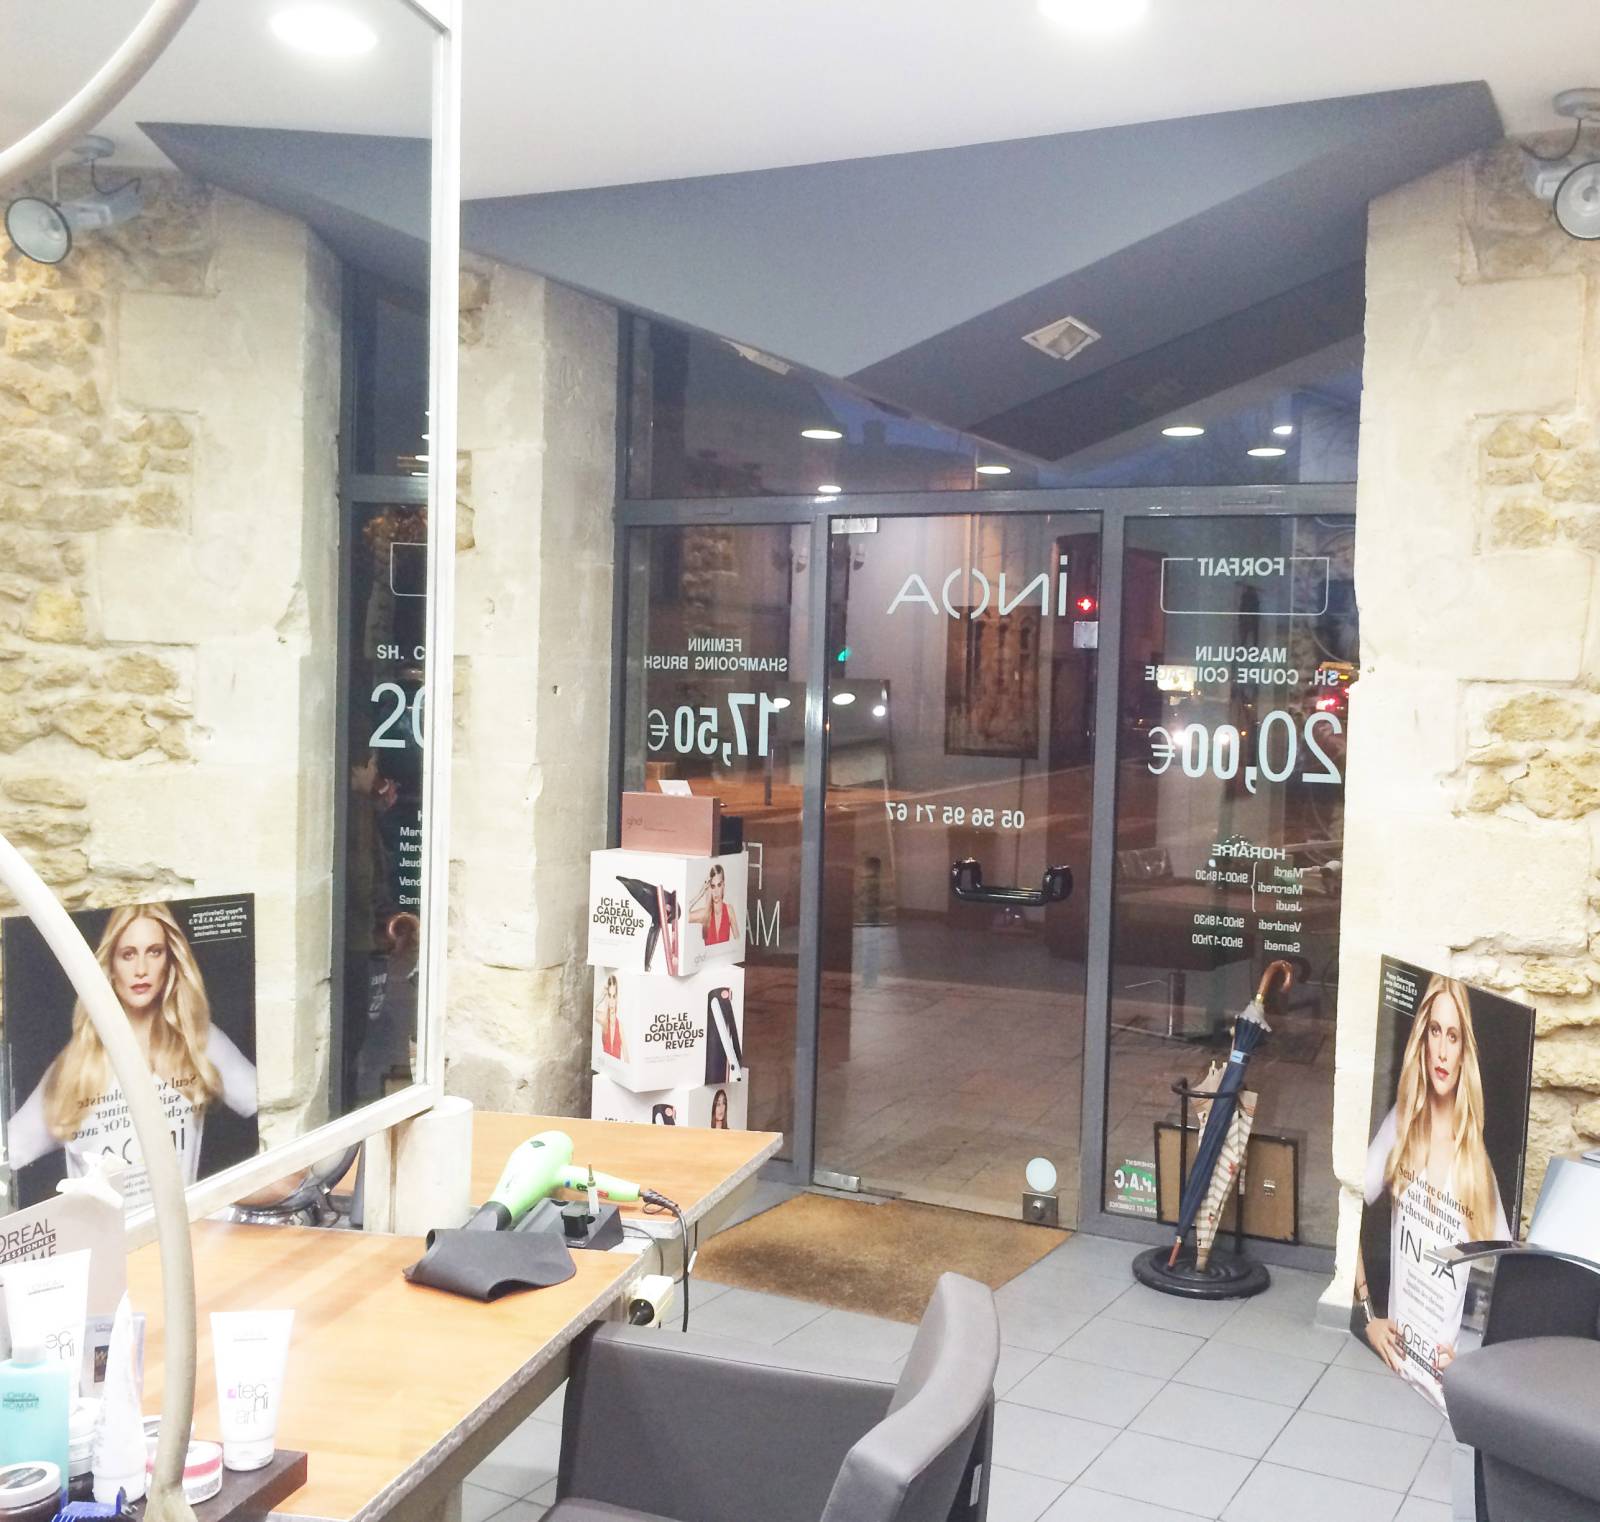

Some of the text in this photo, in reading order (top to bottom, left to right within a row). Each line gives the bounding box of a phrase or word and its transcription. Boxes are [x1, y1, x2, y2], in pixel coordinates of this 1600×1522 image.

[376, 645, 404, 660] SH.
[600, 896, 614, 906] ICI
[596, 904, 634, 918] CADEAU
[592, 913, 645, 928] DONT VOUS
[609, 925, 635, 937] REVEZ
[654, 1013, 669, 1023] ICI
[677, 1012, 688, 1022] LE
[649, 1021, 693, 1033] CADEAU
[645, 1029, 704, 1043] DONT VOUS
[665, 1038, 694, 1050] REVEZ
[1398, 1163, 1475, 1221] Seul votre coloriste
[1407, 1187, 1462, 1231] sait illuminer
[1405, 1202, 1435, 1233] cheveux
